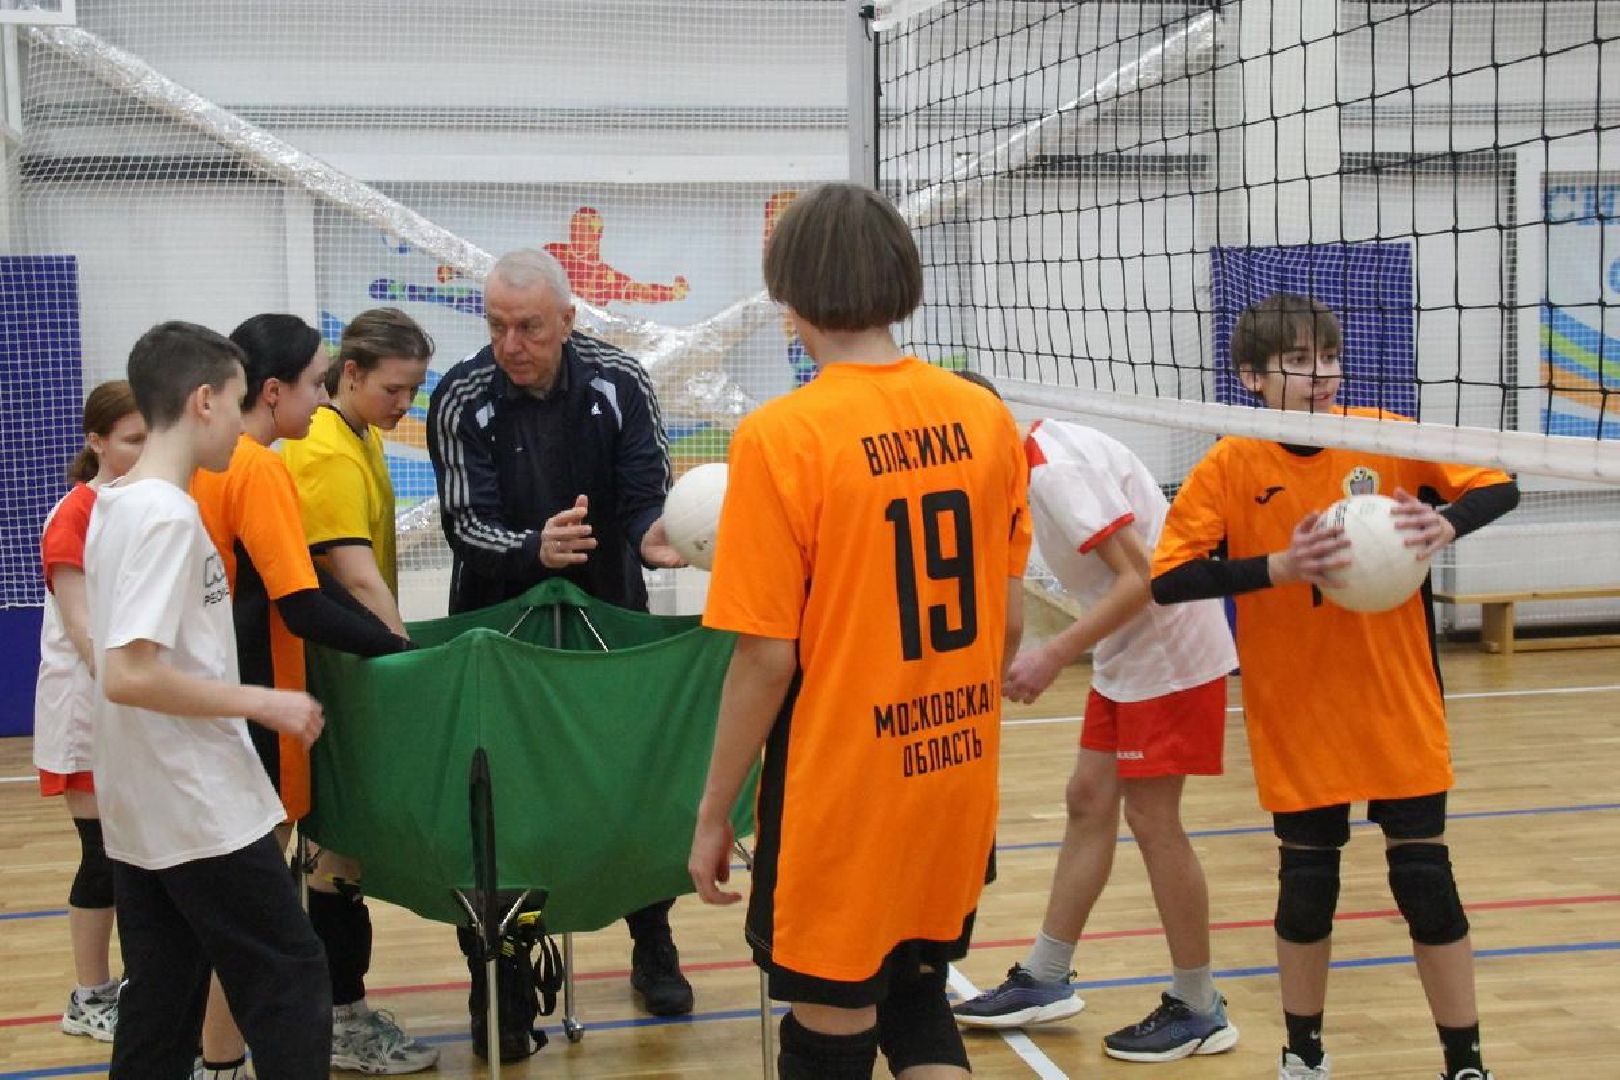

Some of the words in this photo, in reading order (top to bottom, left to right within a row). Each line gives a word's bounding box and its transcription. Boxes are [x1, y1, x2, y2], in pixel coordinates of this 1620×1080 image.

[885, 490, 977, 661] 19
[874, 680, 994, 738] МОСКОВСКА
[904, 727, 982, 777] ОБЛАСТЬ
